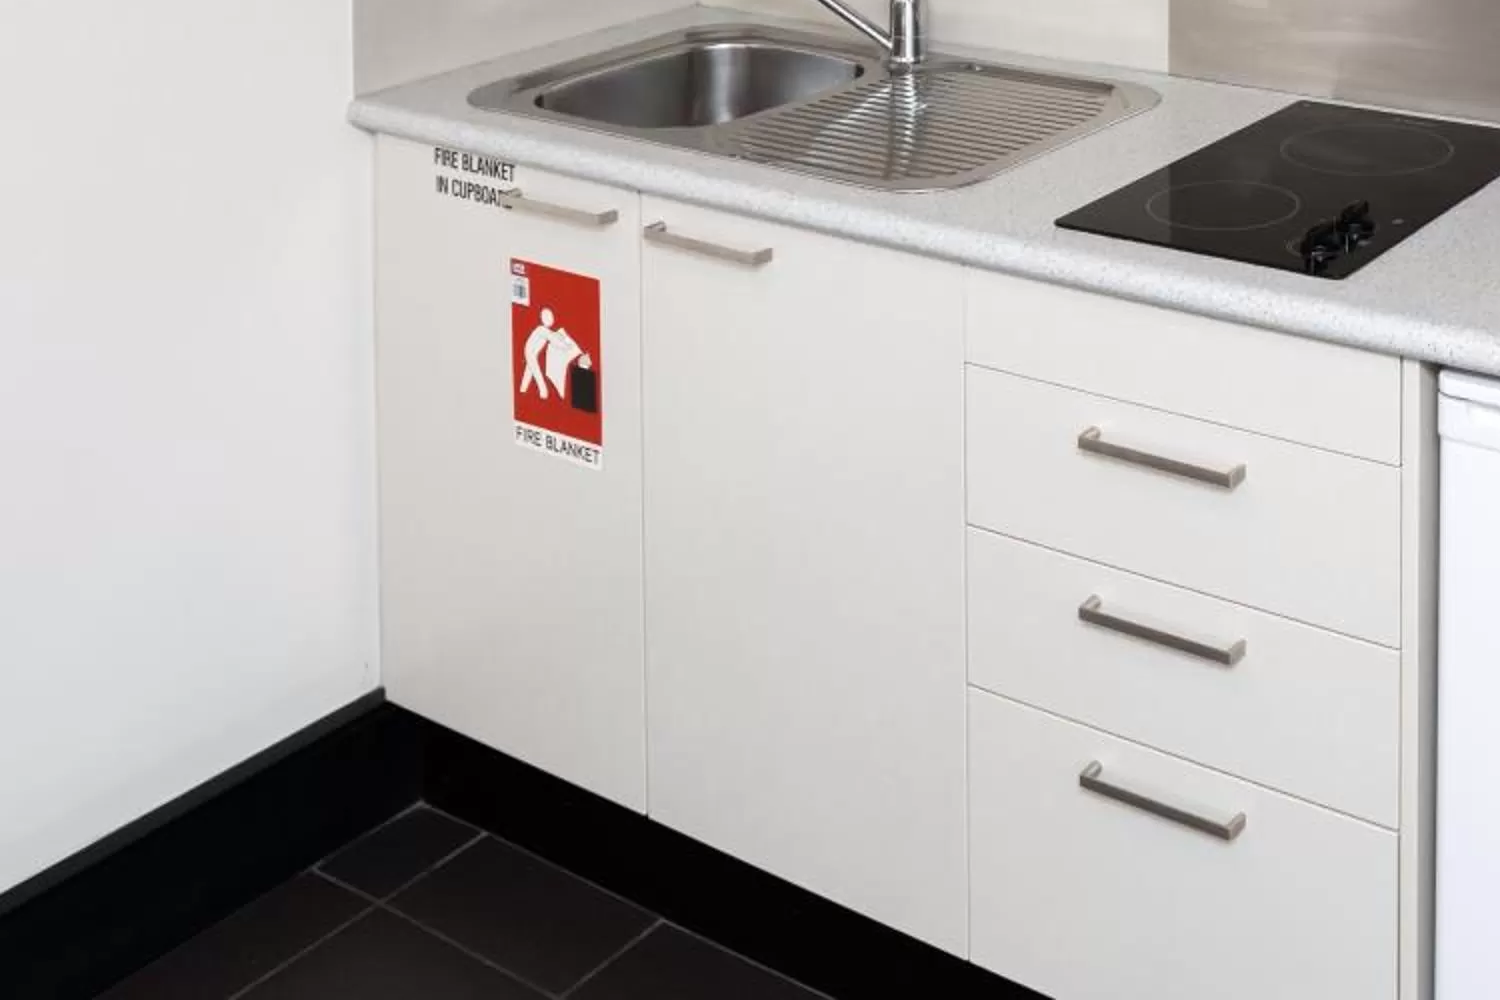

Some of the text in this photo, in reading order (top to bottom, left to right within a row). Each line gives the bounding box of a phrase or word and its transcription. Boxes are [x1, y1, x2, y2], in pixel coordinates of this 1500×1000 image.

[434, 147, 516, 182] FIRE BLANKET
[436, 175, 449, 194] IN
[515, 425, 600, 465] FIRE BLANKET
